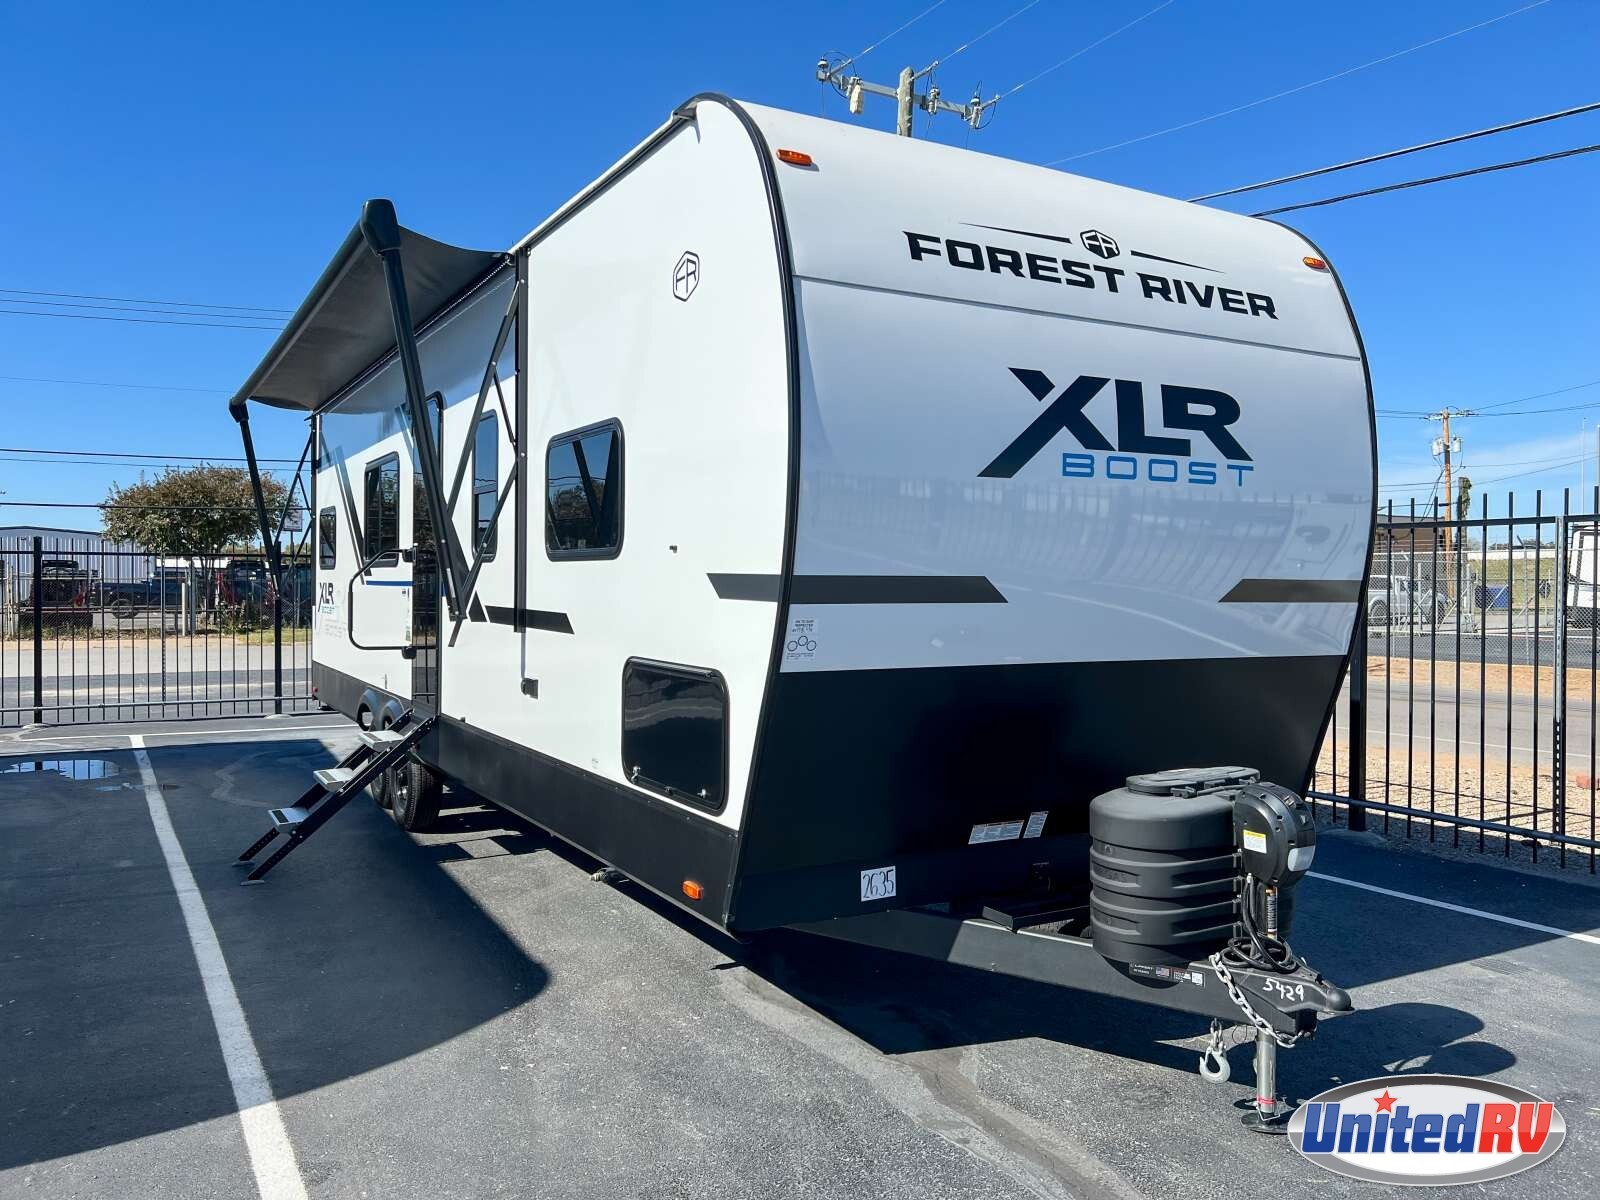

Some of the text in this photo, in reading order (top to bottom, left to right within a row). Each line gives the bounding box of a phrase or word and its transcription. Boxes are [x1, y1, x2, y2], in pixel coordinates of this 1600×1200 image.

[902, 231, 1279, 320] FOREST RIVER
[976, 366, 1254, 479] XLR
[1062, 453, 1254, 487] BOOST
[317, 582, 335, 613] XLR
[862, 868, 895, 900] 2635
[1262, 977, 1305, 1002] 5429
